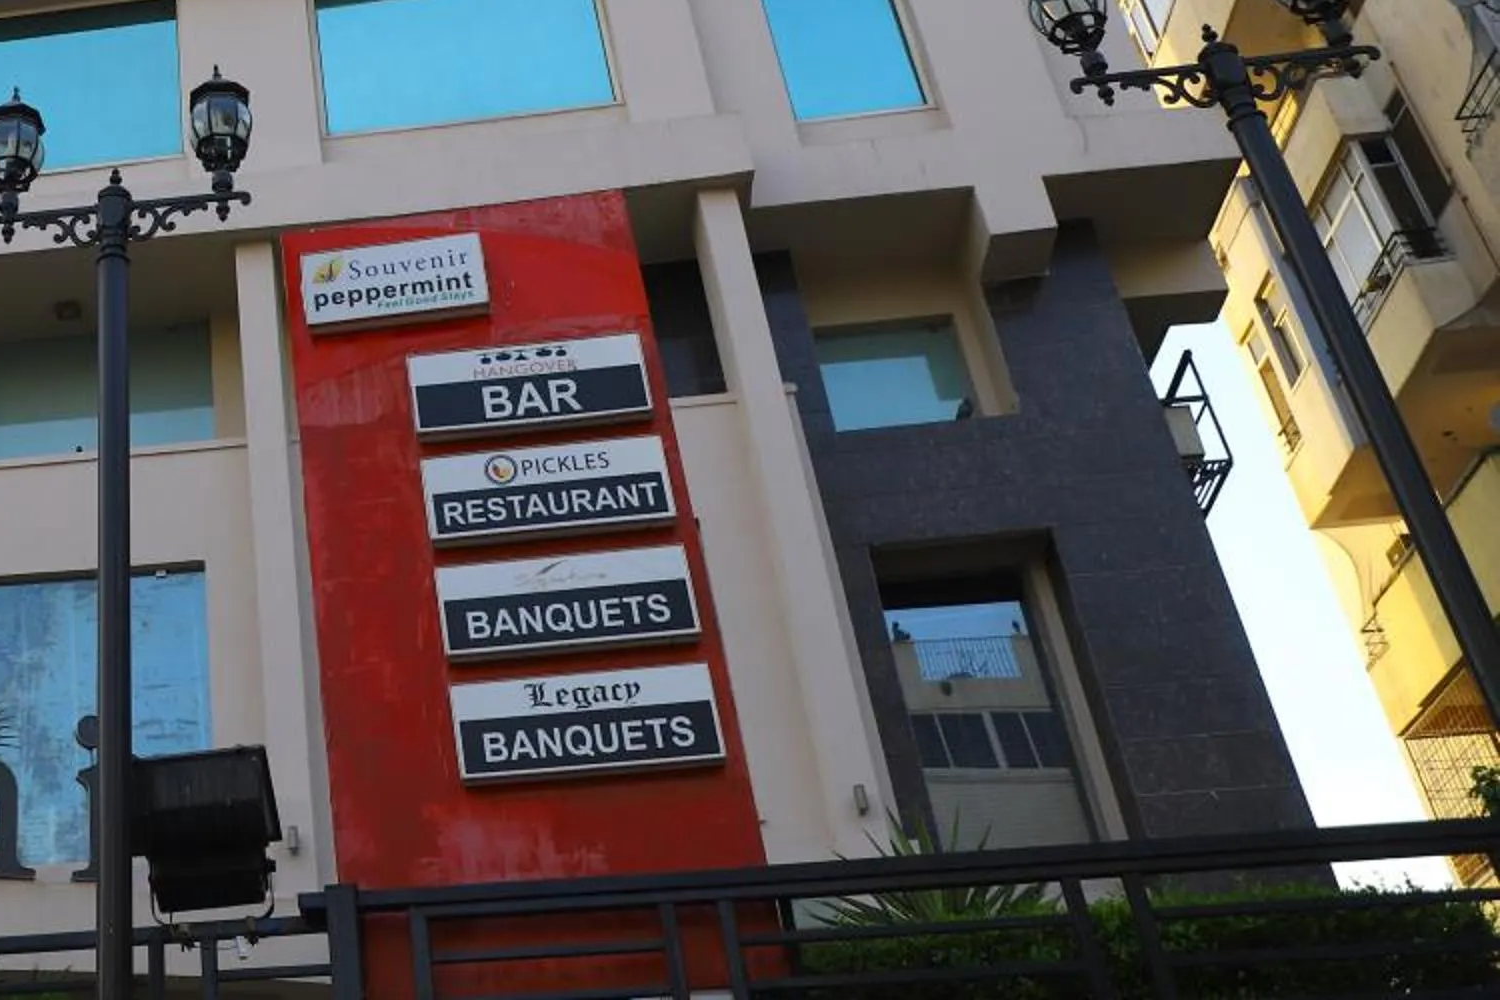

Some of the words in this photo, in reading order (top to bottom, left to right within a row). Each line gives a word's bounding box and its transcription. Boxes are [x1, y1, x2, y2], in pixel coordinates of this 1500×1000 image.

[349, 249, 468, 281] Souvenir
[314, 271, 473, 311] peppermint
[473, 359, 578, 378] HANGOVER
[481, 378, 584, 419] BAR
[521, 450, 610, 476] PICKLES
[443, 482, 659, 526] RESTAURANT
[465, 593, 672, 640] BANQUETS
[523, 681, 641, 709] Legacy
[482, 715, 696, 763] BANQUETS
